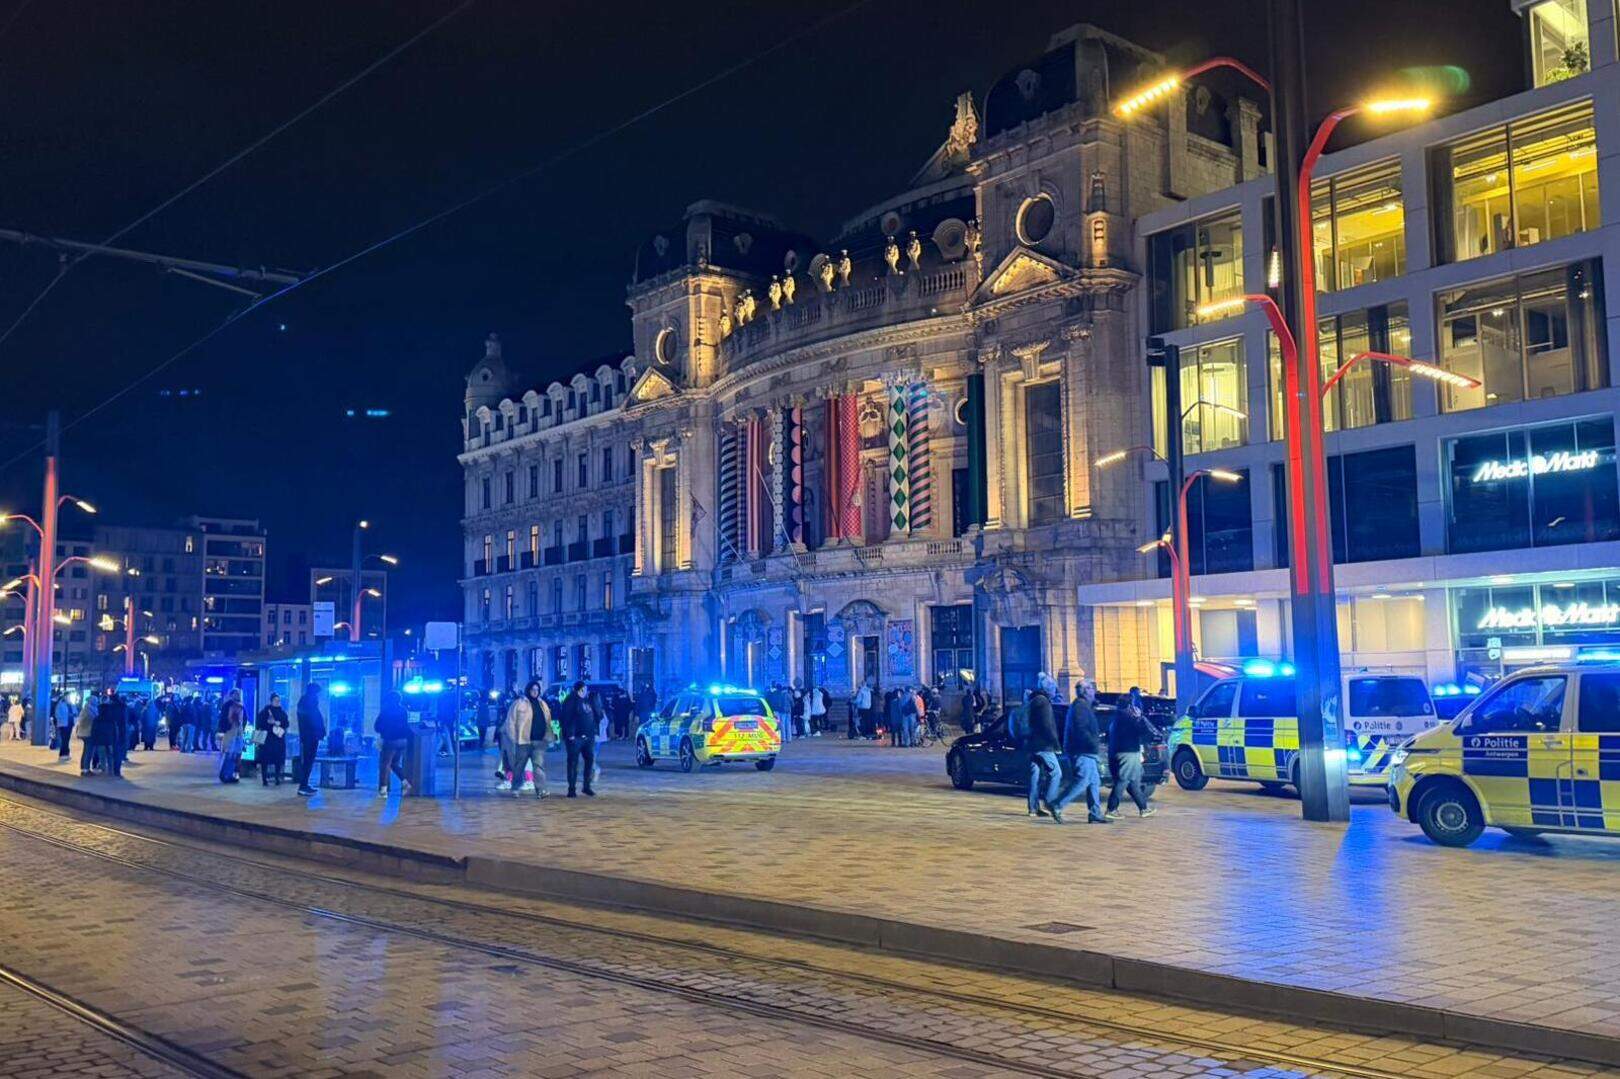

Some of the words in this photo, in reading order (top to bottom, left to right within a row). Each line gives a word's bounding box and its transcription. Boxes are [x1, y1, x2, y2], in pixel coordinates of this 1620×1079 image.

[1546, 450, 1598, 472] Markt
[1364, 721, 1391, 730] Politie
[1484, 737, 1519, 748] Politie
